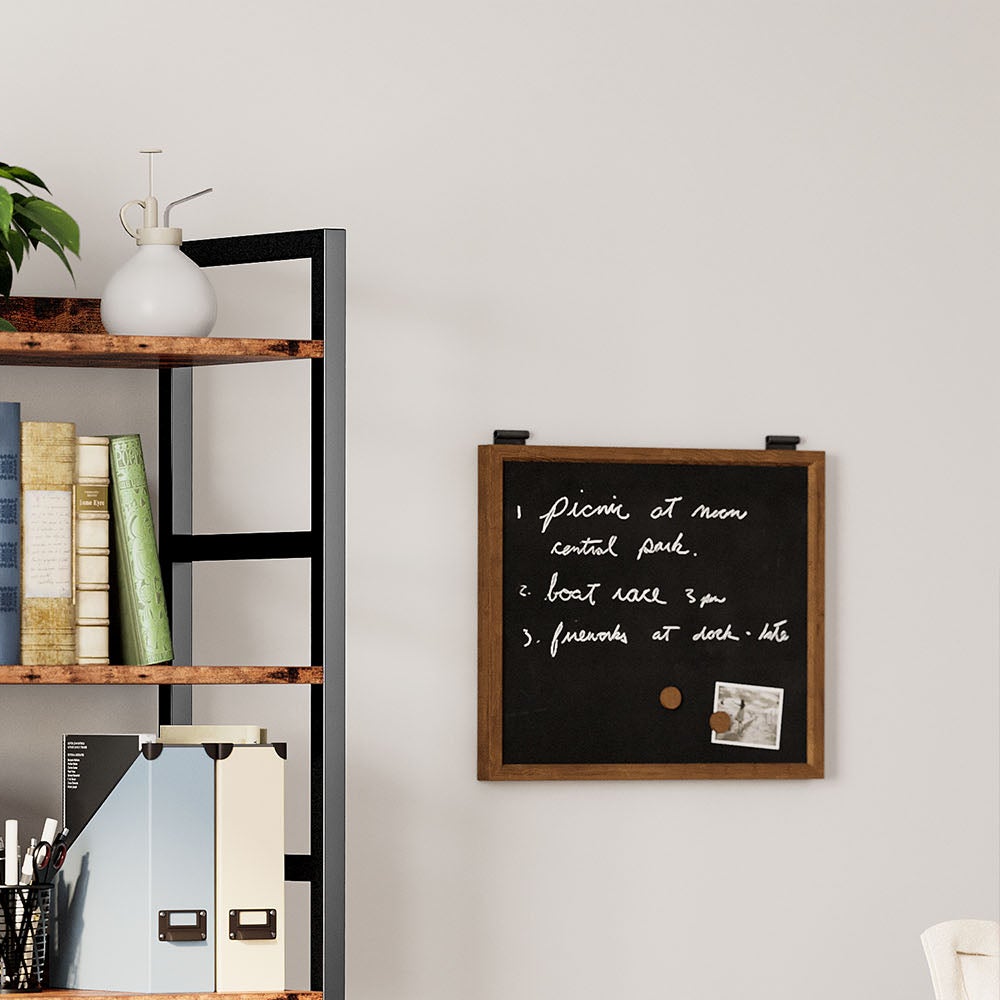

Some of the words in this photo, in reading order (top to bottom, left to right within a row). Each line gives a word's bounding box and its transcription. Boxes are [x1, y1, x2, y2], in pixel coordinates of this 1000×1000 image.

[650, 497, 682, 519] at
[551, 536, 618, 556] central
[544, 572, 600, 605] boat
[612, 587, 667, 604] race
[551, 622, 627, 657] fireworks
[652, 626, 680, 641] at
